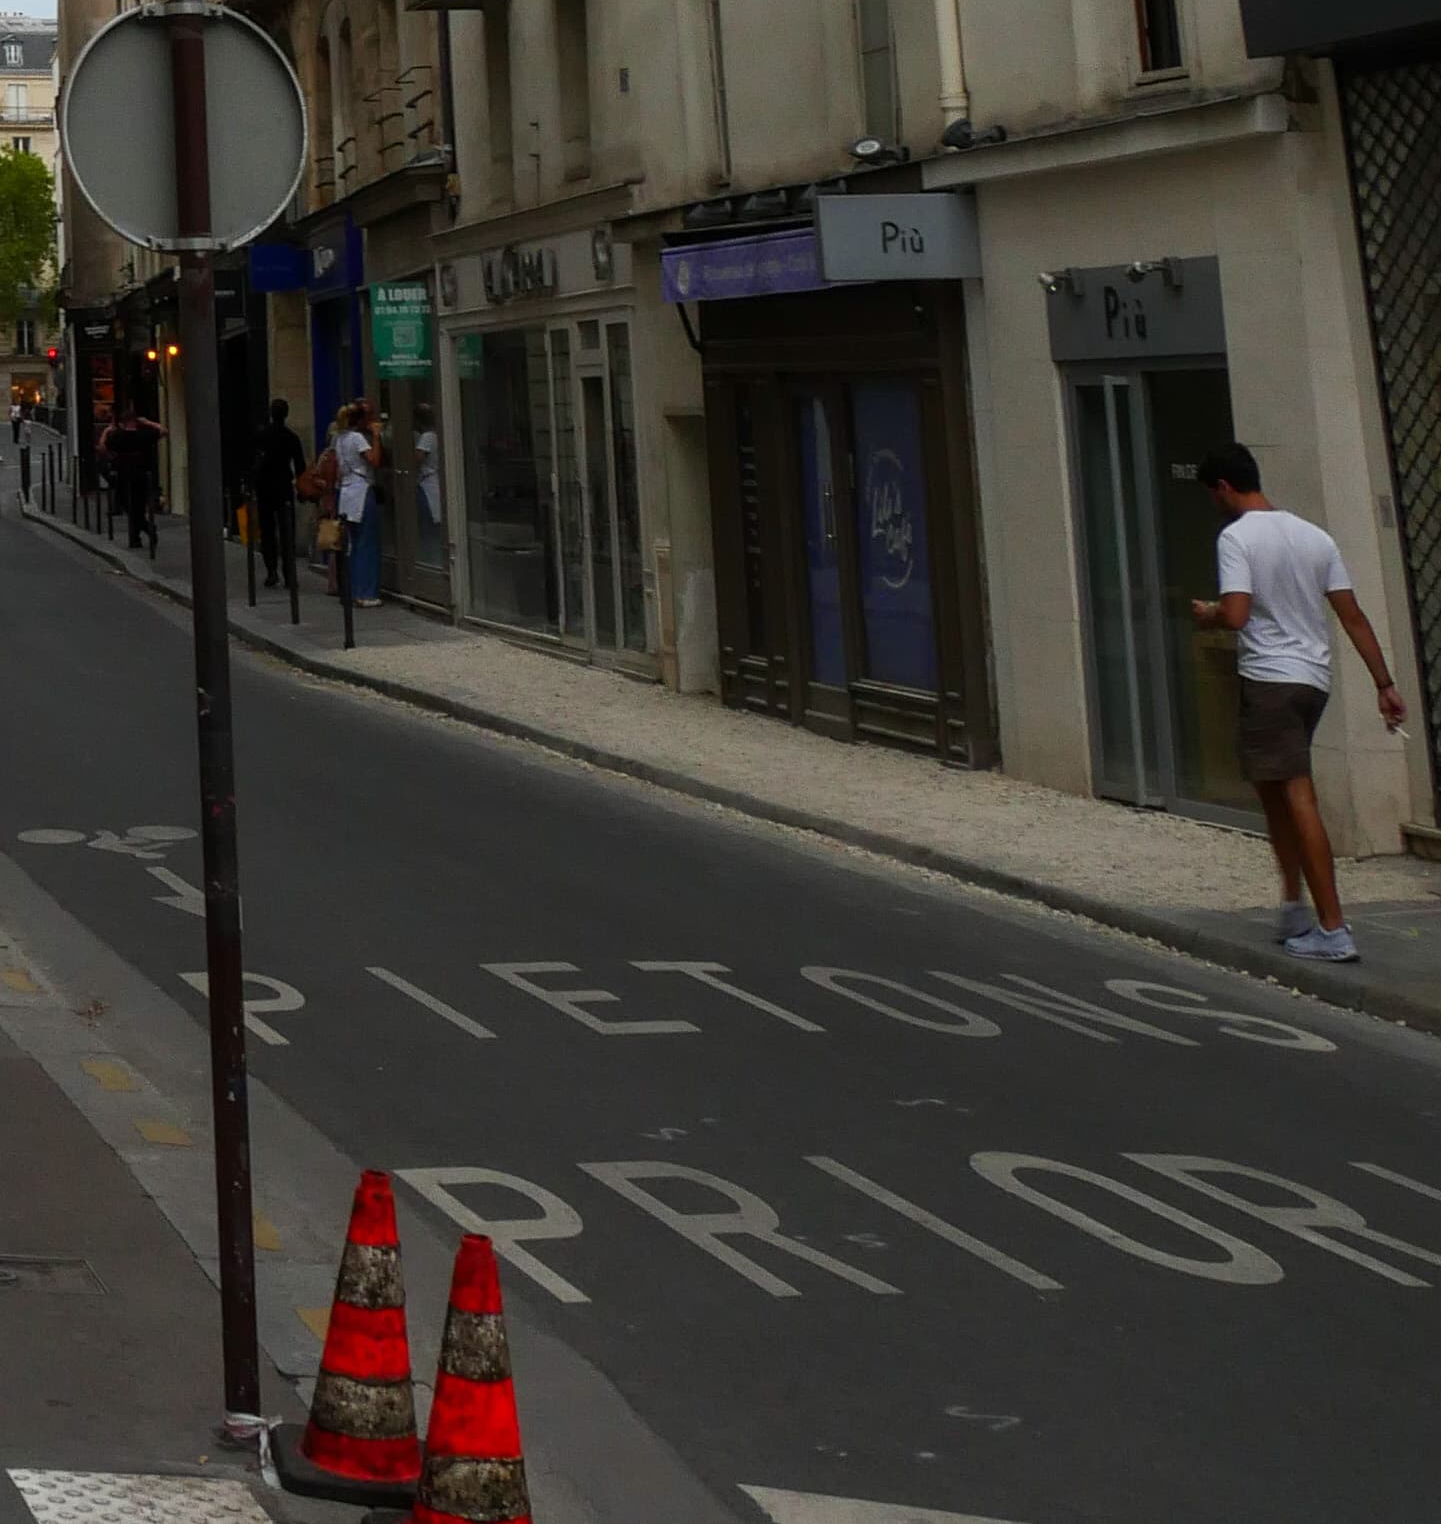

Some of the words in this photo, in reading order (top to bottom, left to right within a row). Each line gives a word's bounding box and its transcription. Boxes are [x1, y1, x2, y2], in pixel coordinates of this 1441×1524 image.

[880, 221, 925, 253] Più
[1103, 285, 1148, 342] Più
[176, 960, 1339, 1052] PIETONS
